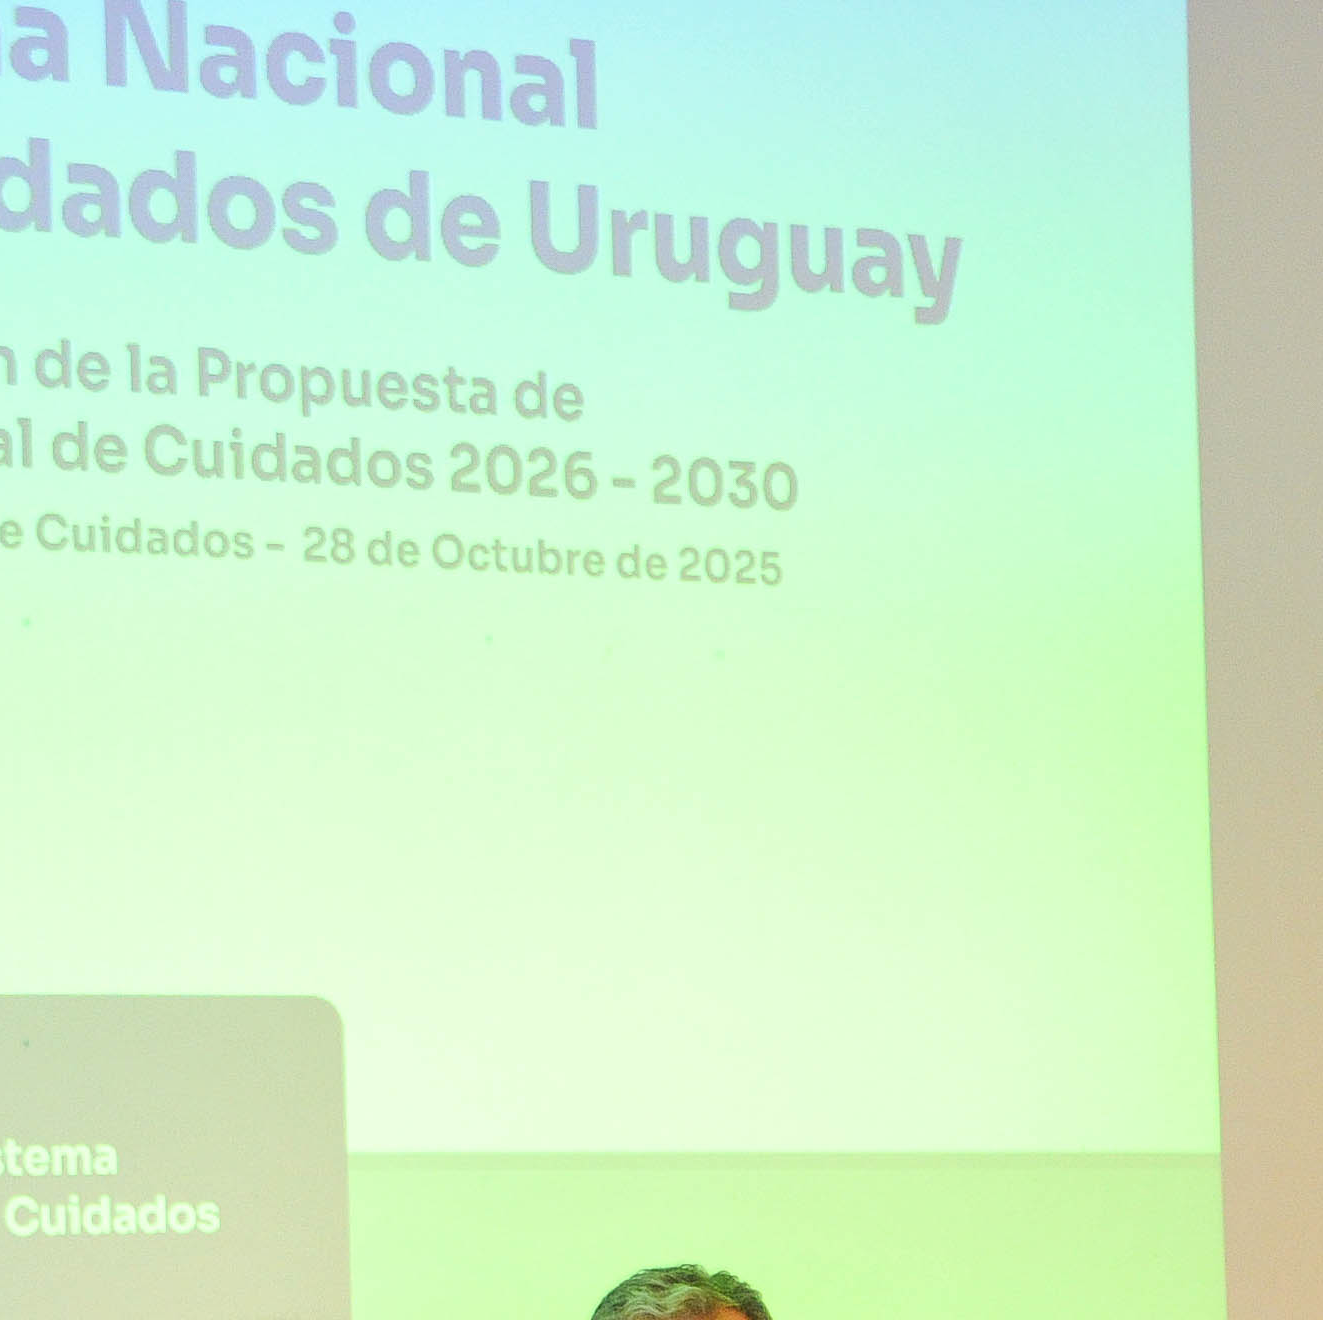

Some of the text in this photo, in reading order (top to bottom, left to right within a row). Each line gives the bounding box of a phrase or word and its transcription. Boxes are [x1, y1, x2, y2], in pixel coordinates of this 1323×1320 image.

[104, 0, 598, 130] Nacional
[365, 169, 502, 268] de
[529, 179, 963, 326] Uruguay
[34, 338, 112, 392] de
[126, 342, 177, 396] la
[197, 346, 498, 418] Propuesta
[514, 370, 585, 422] de
[51, 420, 129, 474] de
[144, 424, 435, 491] Cuidados
[449, 441, 598, 500] 2026
[651, 454, 799, 512] 2030
[36, 512, 256, 561] Cuidados
[303, 525, 357, 566] 28
[367, 530, 422, 569] de
[432, 533, 606, 579] Octubre
[616, 544, 668, 582] de
[678, 546, 785, 587] 2025
[3, 1194, 221, 1237] Cuidados
